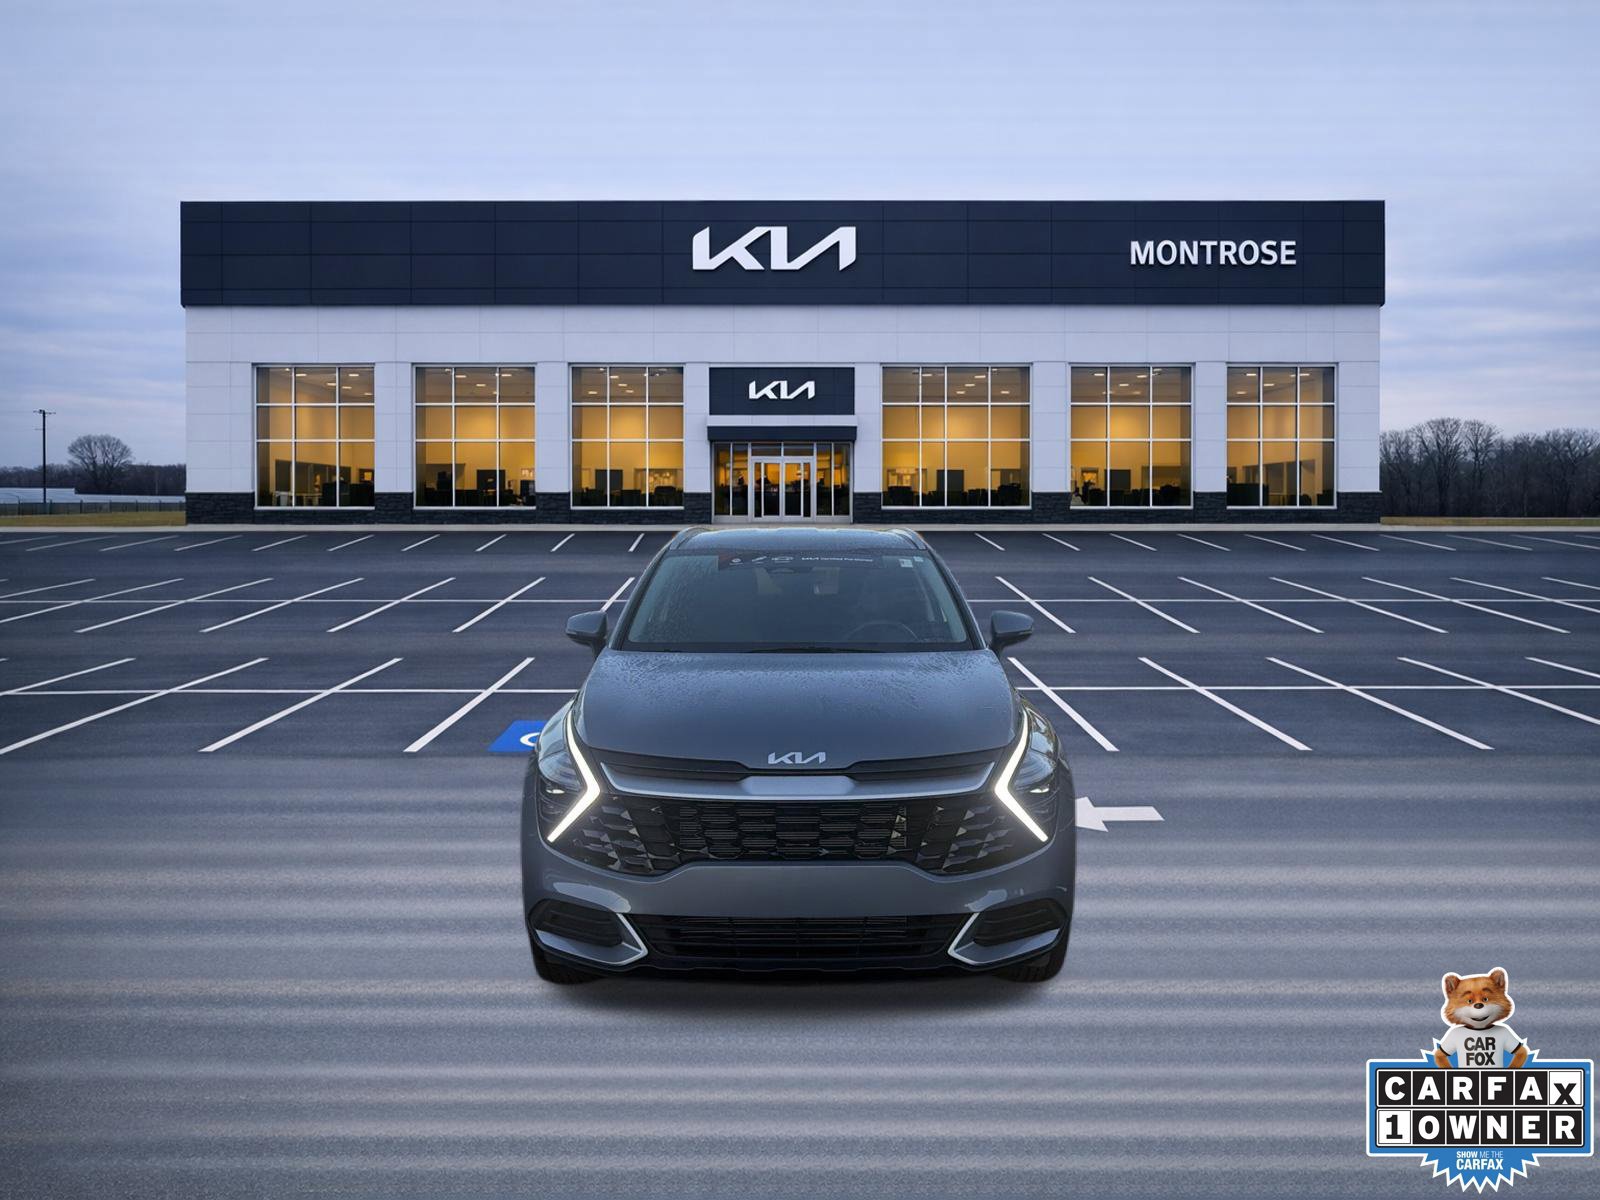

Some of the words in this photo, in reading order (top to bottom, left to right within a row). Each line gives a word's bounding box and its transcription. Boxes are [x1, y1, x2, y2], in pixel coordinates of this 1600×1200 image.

[693, 226, 857, 271] KIA
[1130, 239, 1297, 266] MONTROSE
[749, 381, 816, 400] KIA
[768, 752, 826, 765] KIA
